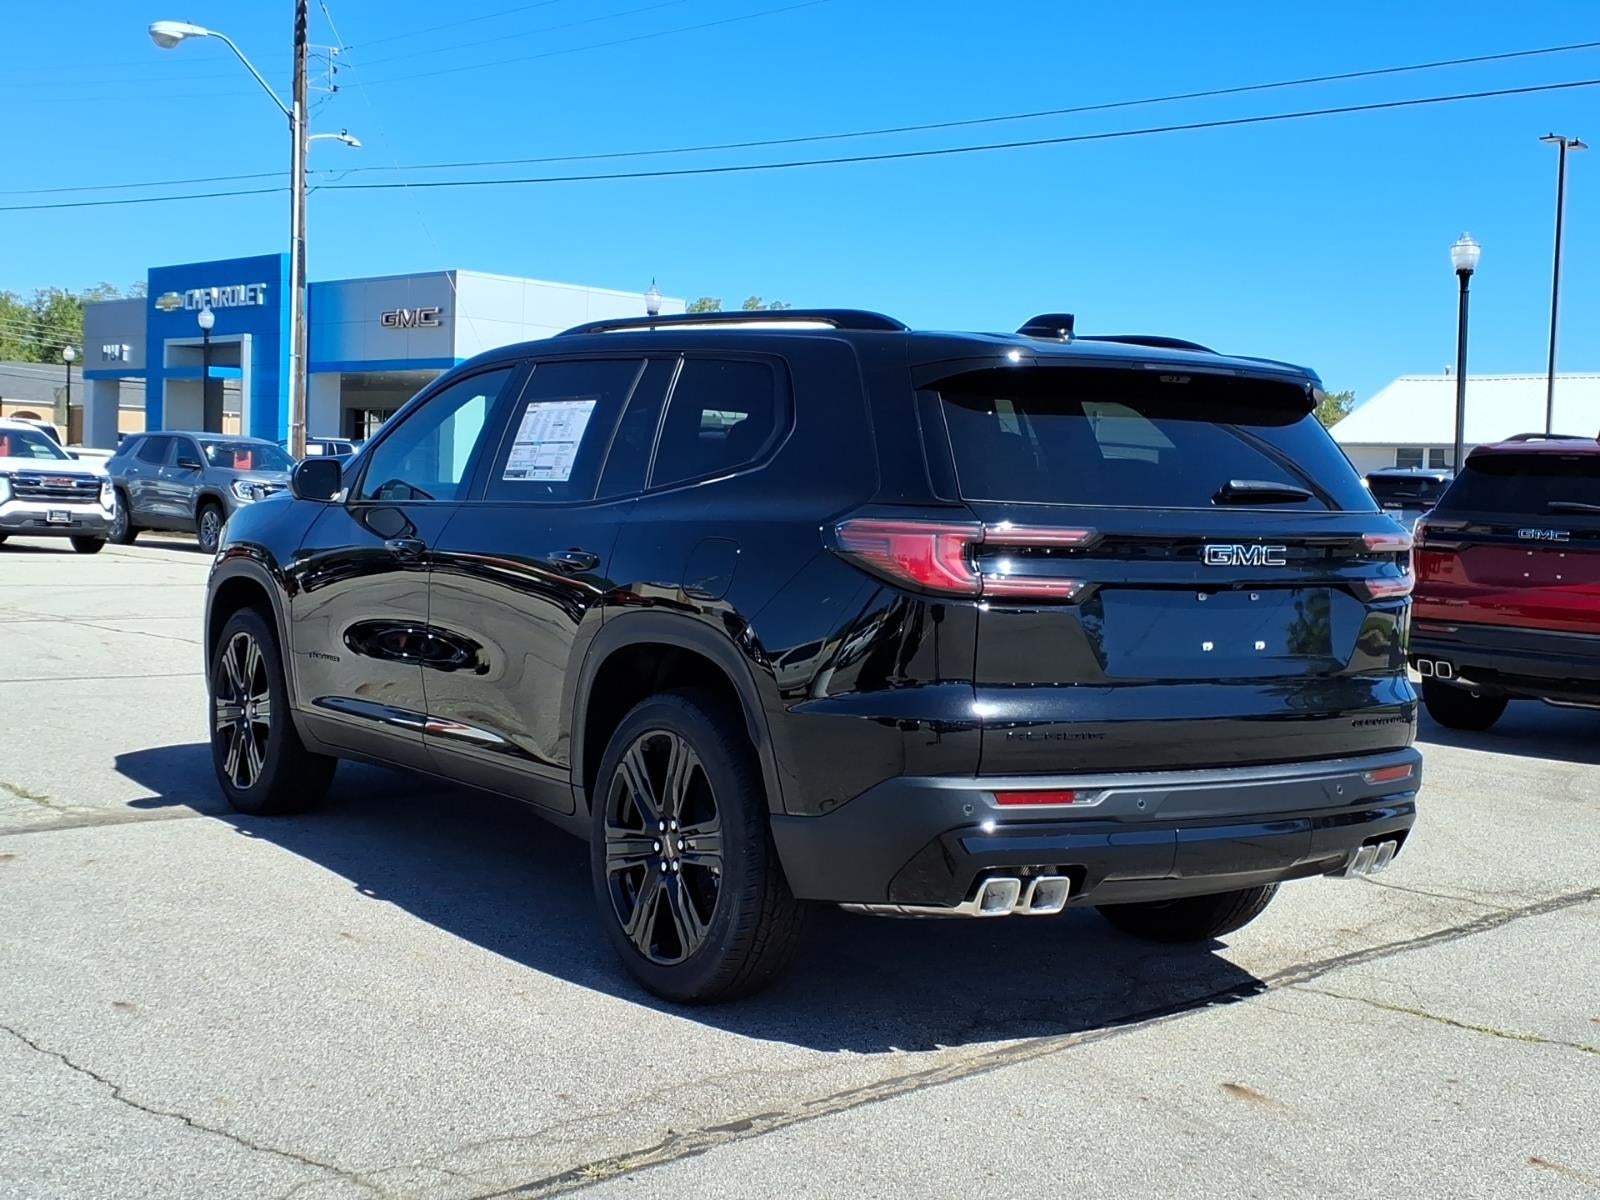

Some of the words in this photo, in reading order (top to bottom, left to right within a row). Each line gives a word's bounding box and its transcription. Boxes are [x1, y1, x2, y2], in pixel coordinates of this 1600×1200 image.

[184, 283, 267, 310] CHEVROLET
[381, 306, 440, 328] GMC
[1517, 528, 1571, 542] GMC
[1204, 543, 1287, 566] GMC
